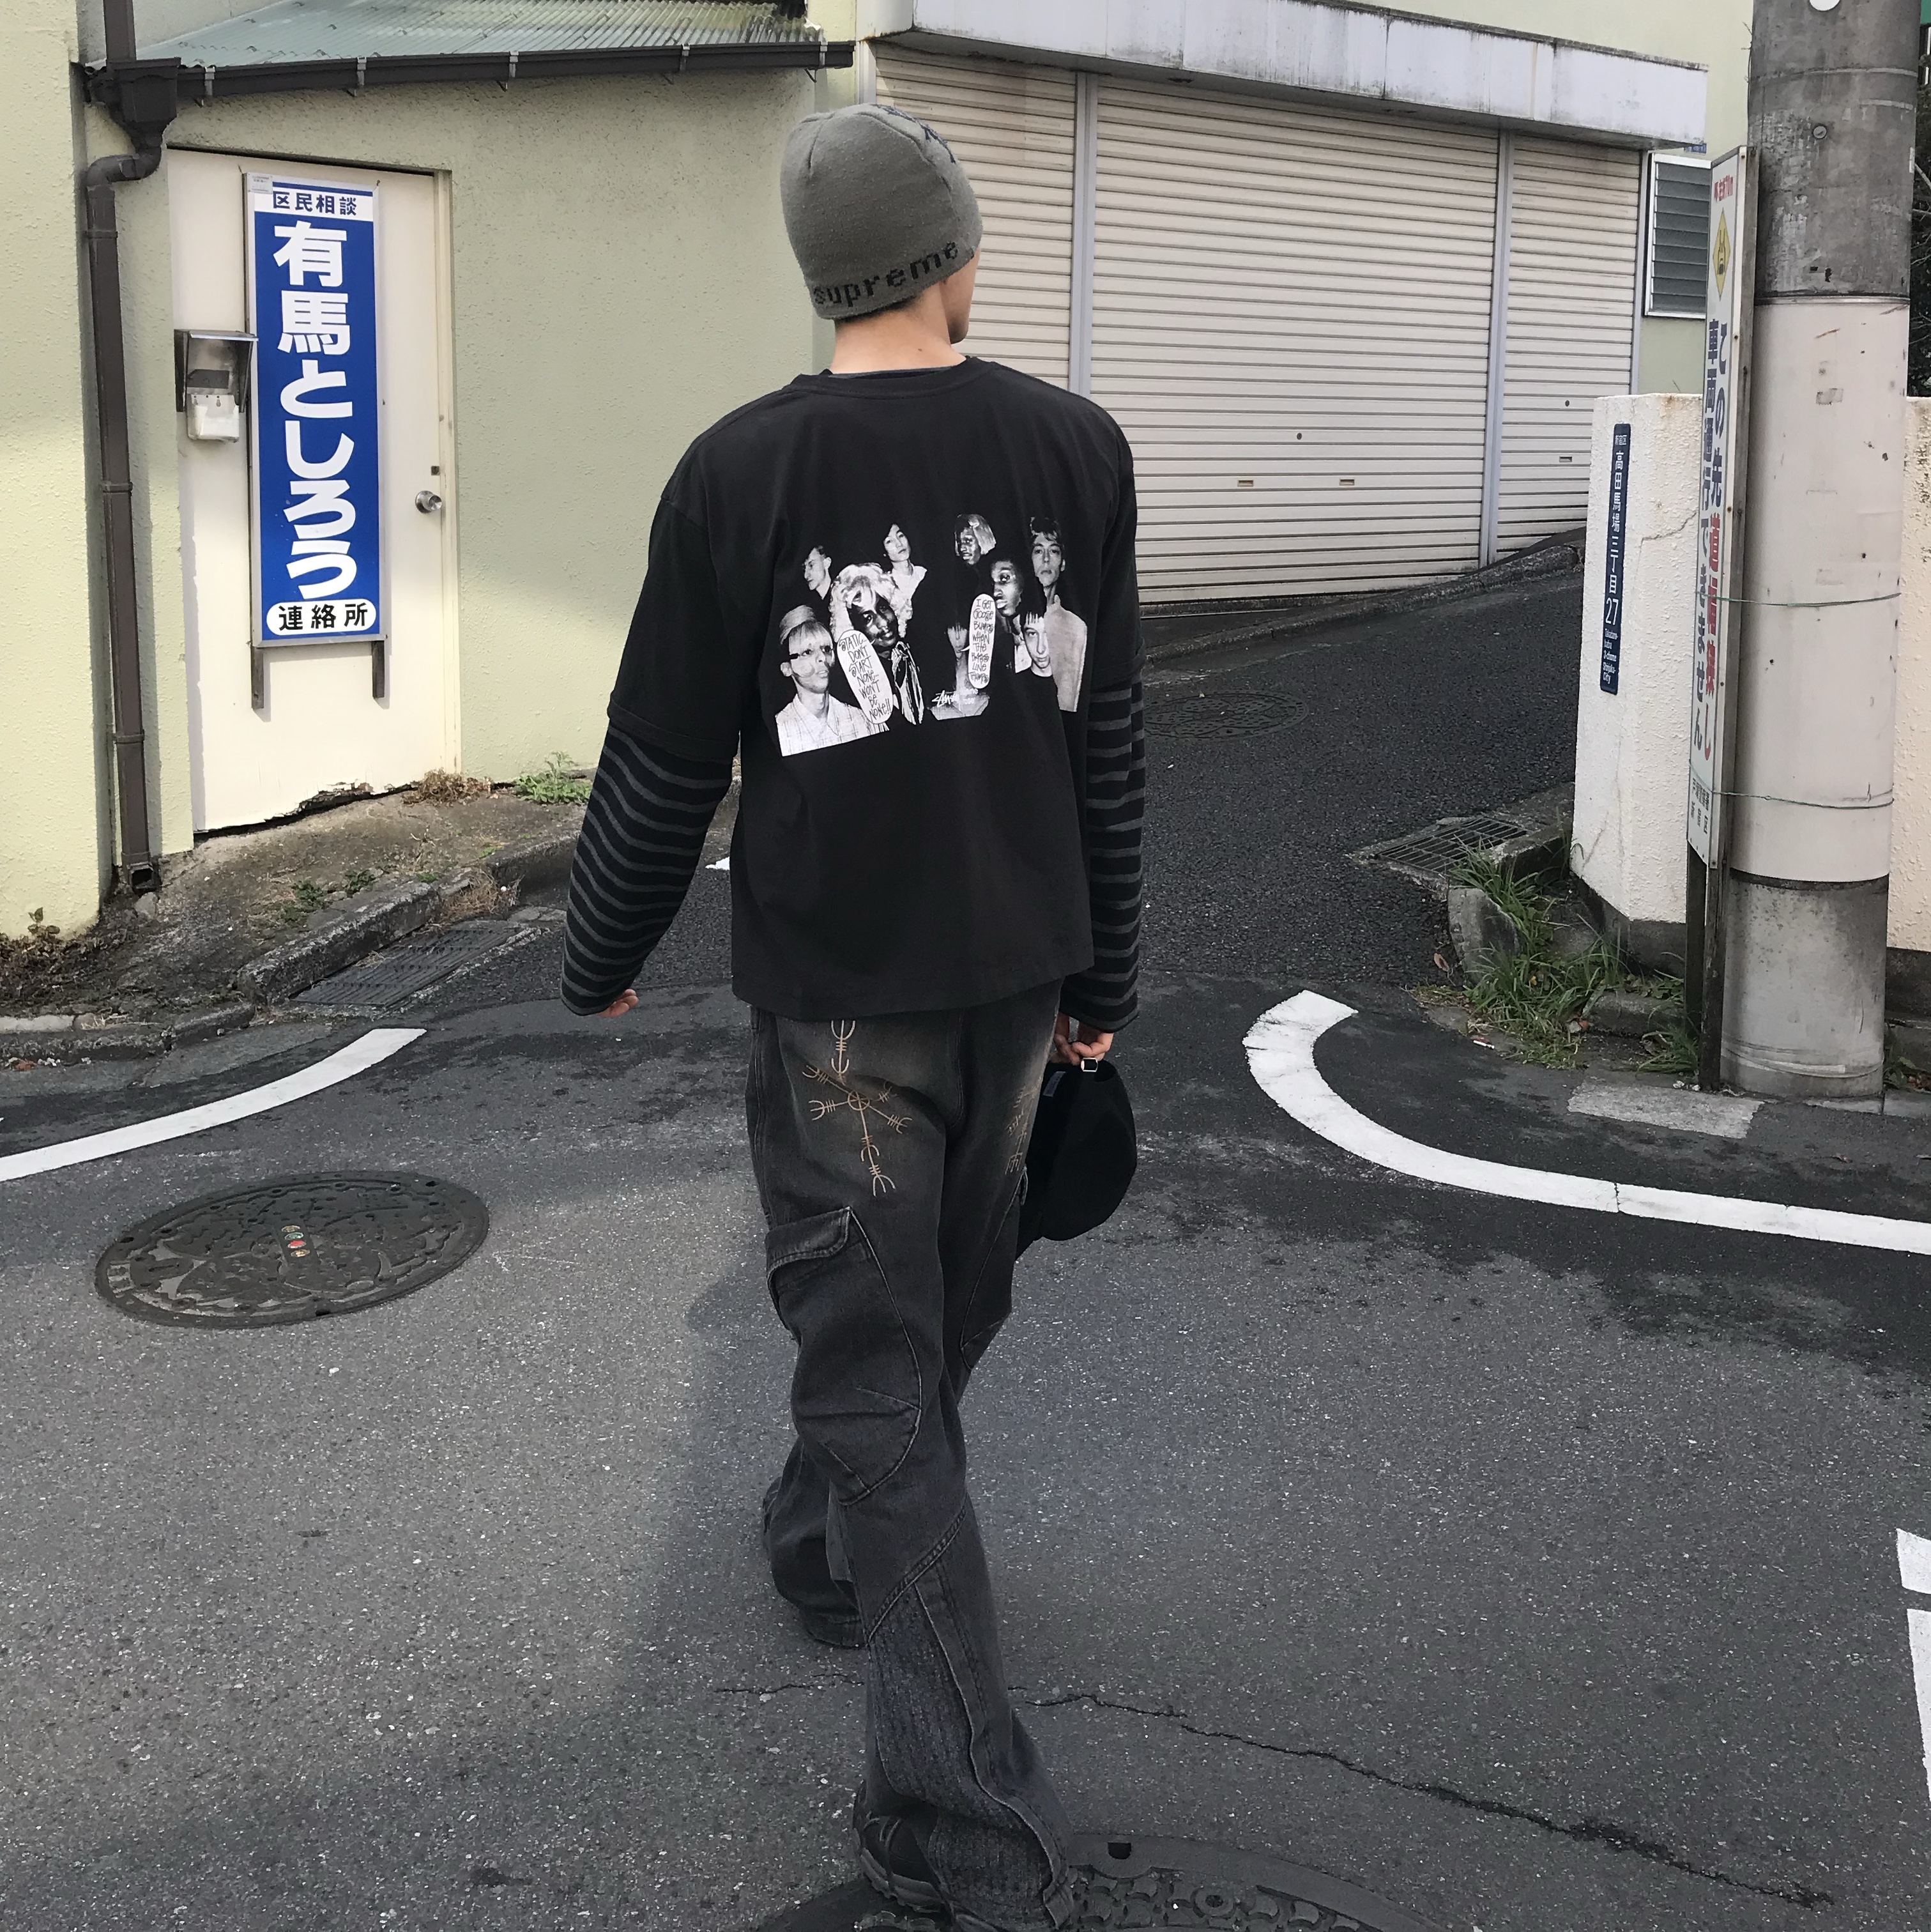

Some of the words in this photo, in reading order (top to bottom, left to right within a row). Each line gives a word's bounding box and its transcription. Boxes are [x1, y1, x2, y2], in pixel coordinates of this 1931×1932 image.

[273, 191, 357, 216] 区民相談
[813, 241, 958, 307] supreme
[273, 220, 358, 600] 有馬としろう
[279, 602, 369, 631] 連絡所
